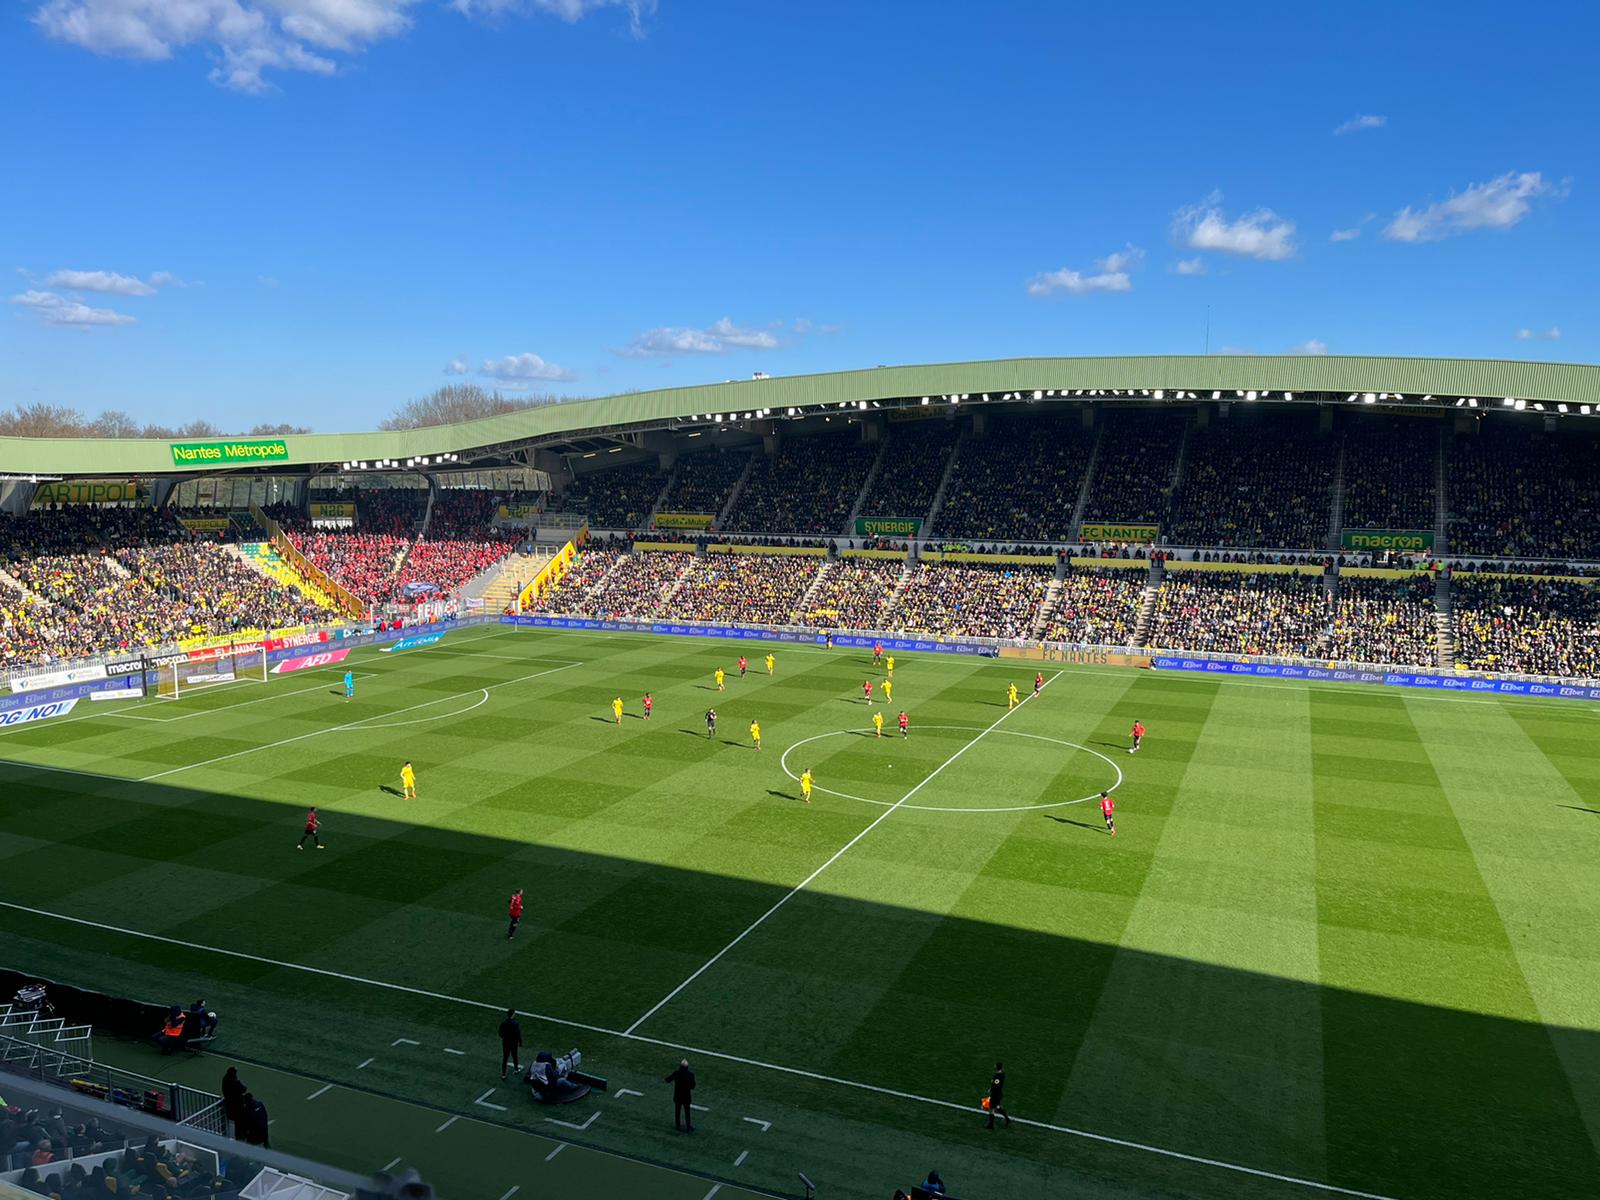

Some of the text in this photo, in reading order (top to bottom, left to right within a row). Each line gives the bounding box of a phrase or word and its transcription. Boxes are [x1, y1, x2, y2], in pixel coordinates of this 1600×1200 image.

[173, 443, 286, 460] Nantes Métropole
[39, 484, 134, 503] ARTIPOL
[864, 521, 915, 533] SYNERGIE
[1083, 527, 1157, 539] FC NANTES
[1351, 535, 1424, 548] macron
[282, 632, 320, 649] SYNERGIE
[301, 653, 332, 668] AFD
[1042, 649, 1107, 665] FC NANTES
